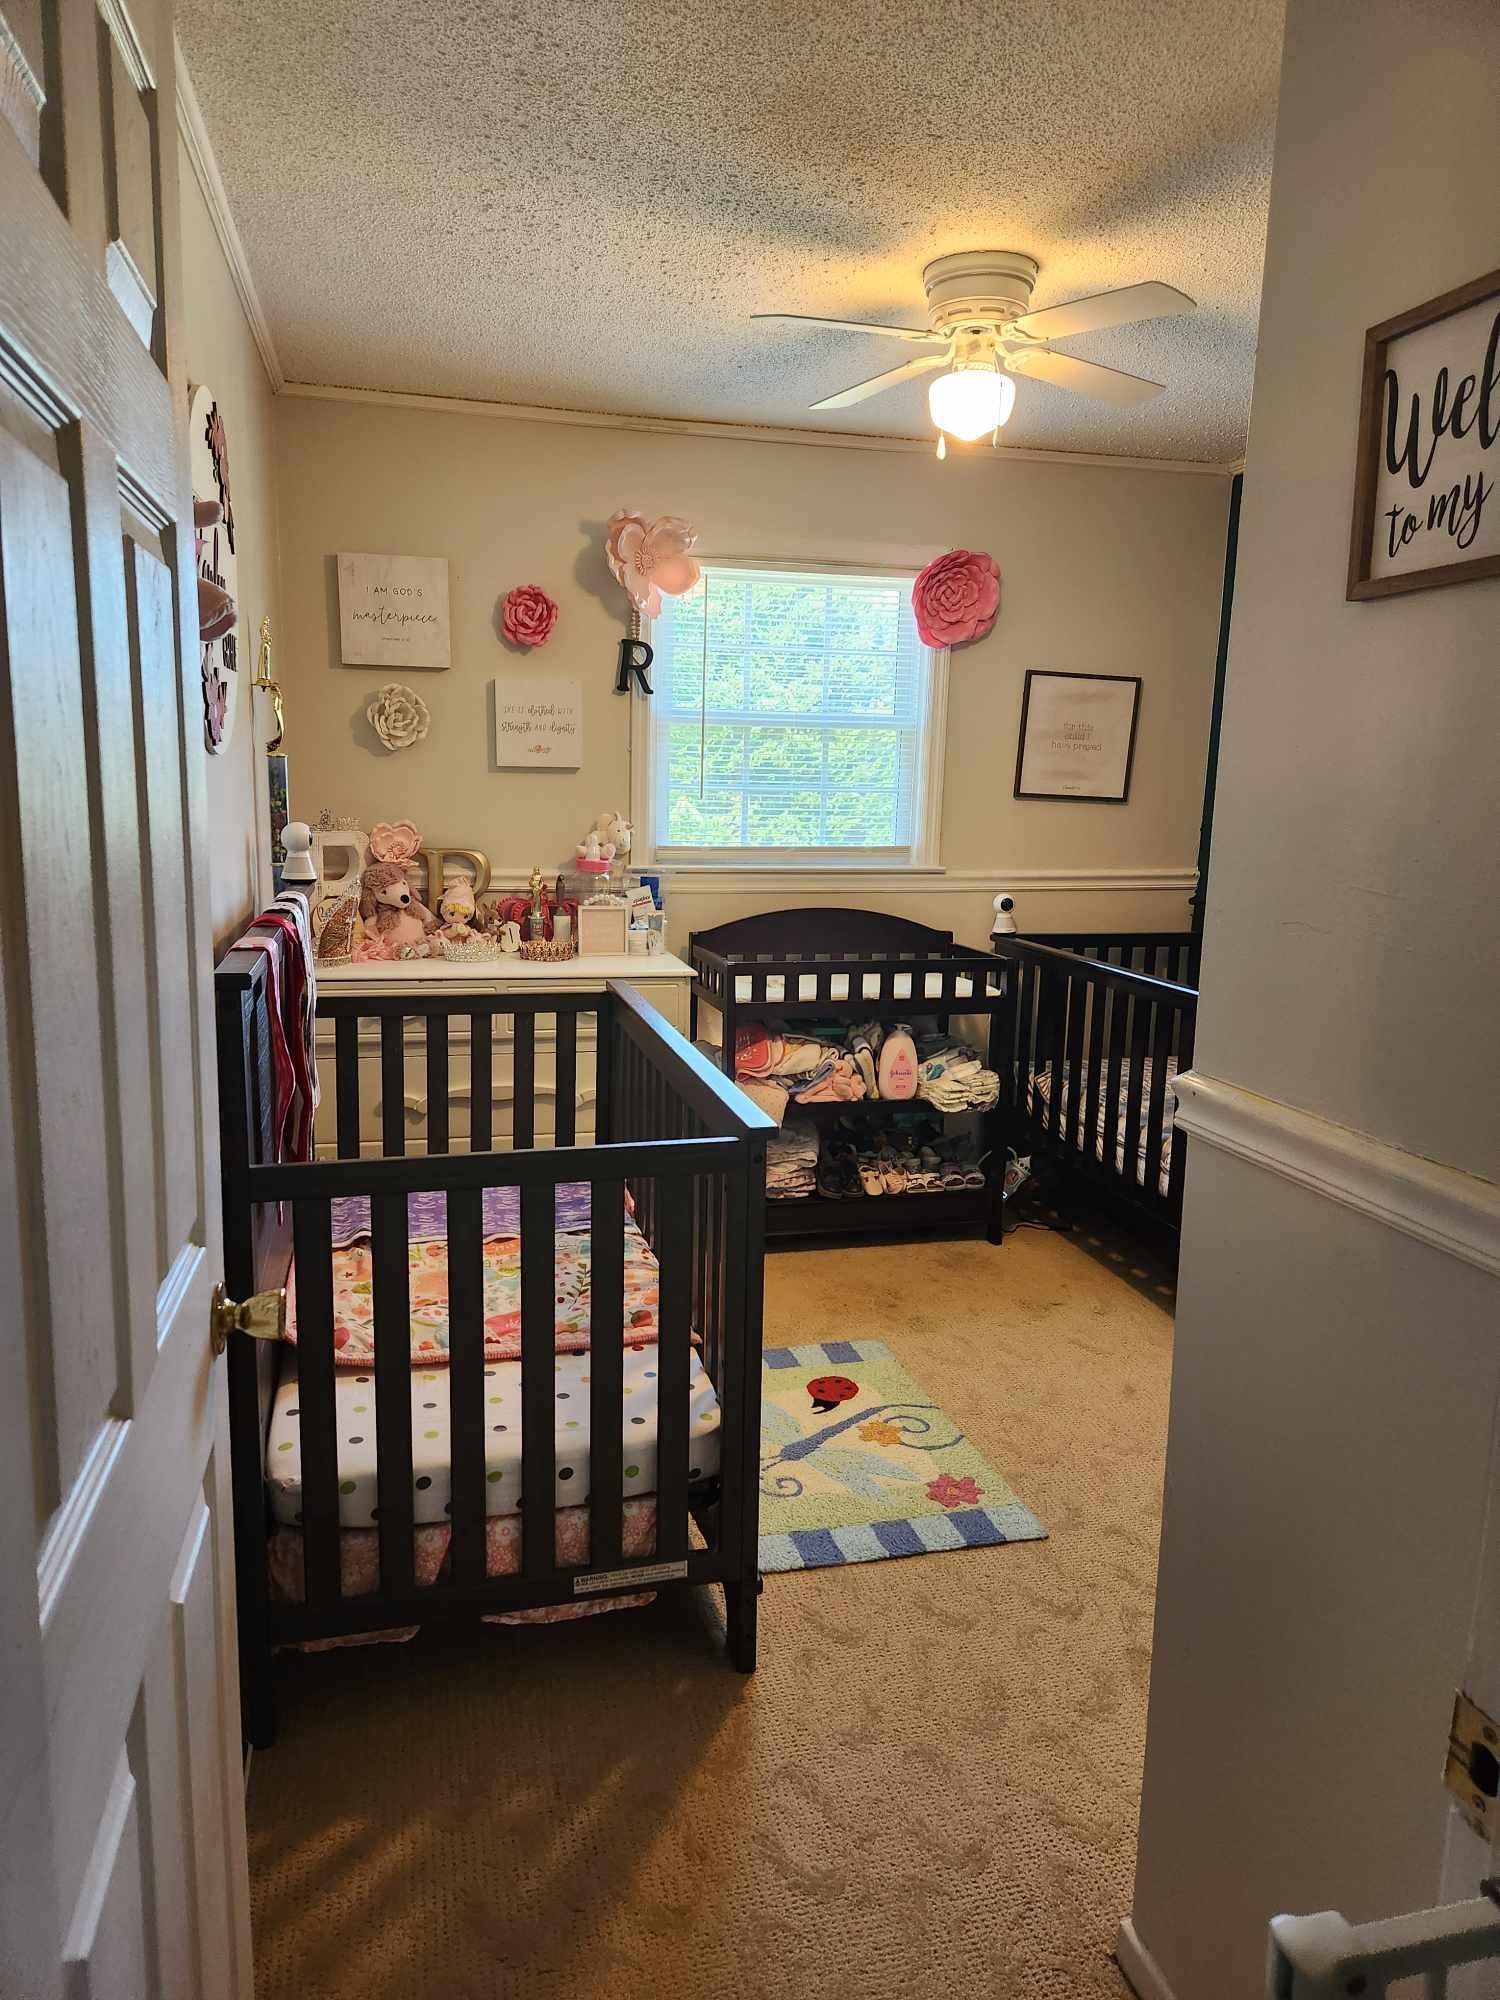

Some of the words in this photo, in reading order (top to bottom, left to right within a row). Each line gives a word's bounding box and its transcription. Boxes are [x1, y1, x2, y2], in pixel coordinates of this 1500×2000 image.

[1385, 503, 1423, 559] to
[1427, 471, 1494, 549] my
[374, 587, 388, 596] AM
[392, 588, 423, 597] GOD'S
[352, 605, 438, 626] masterpiece
[617, 638, 654, 695] R
